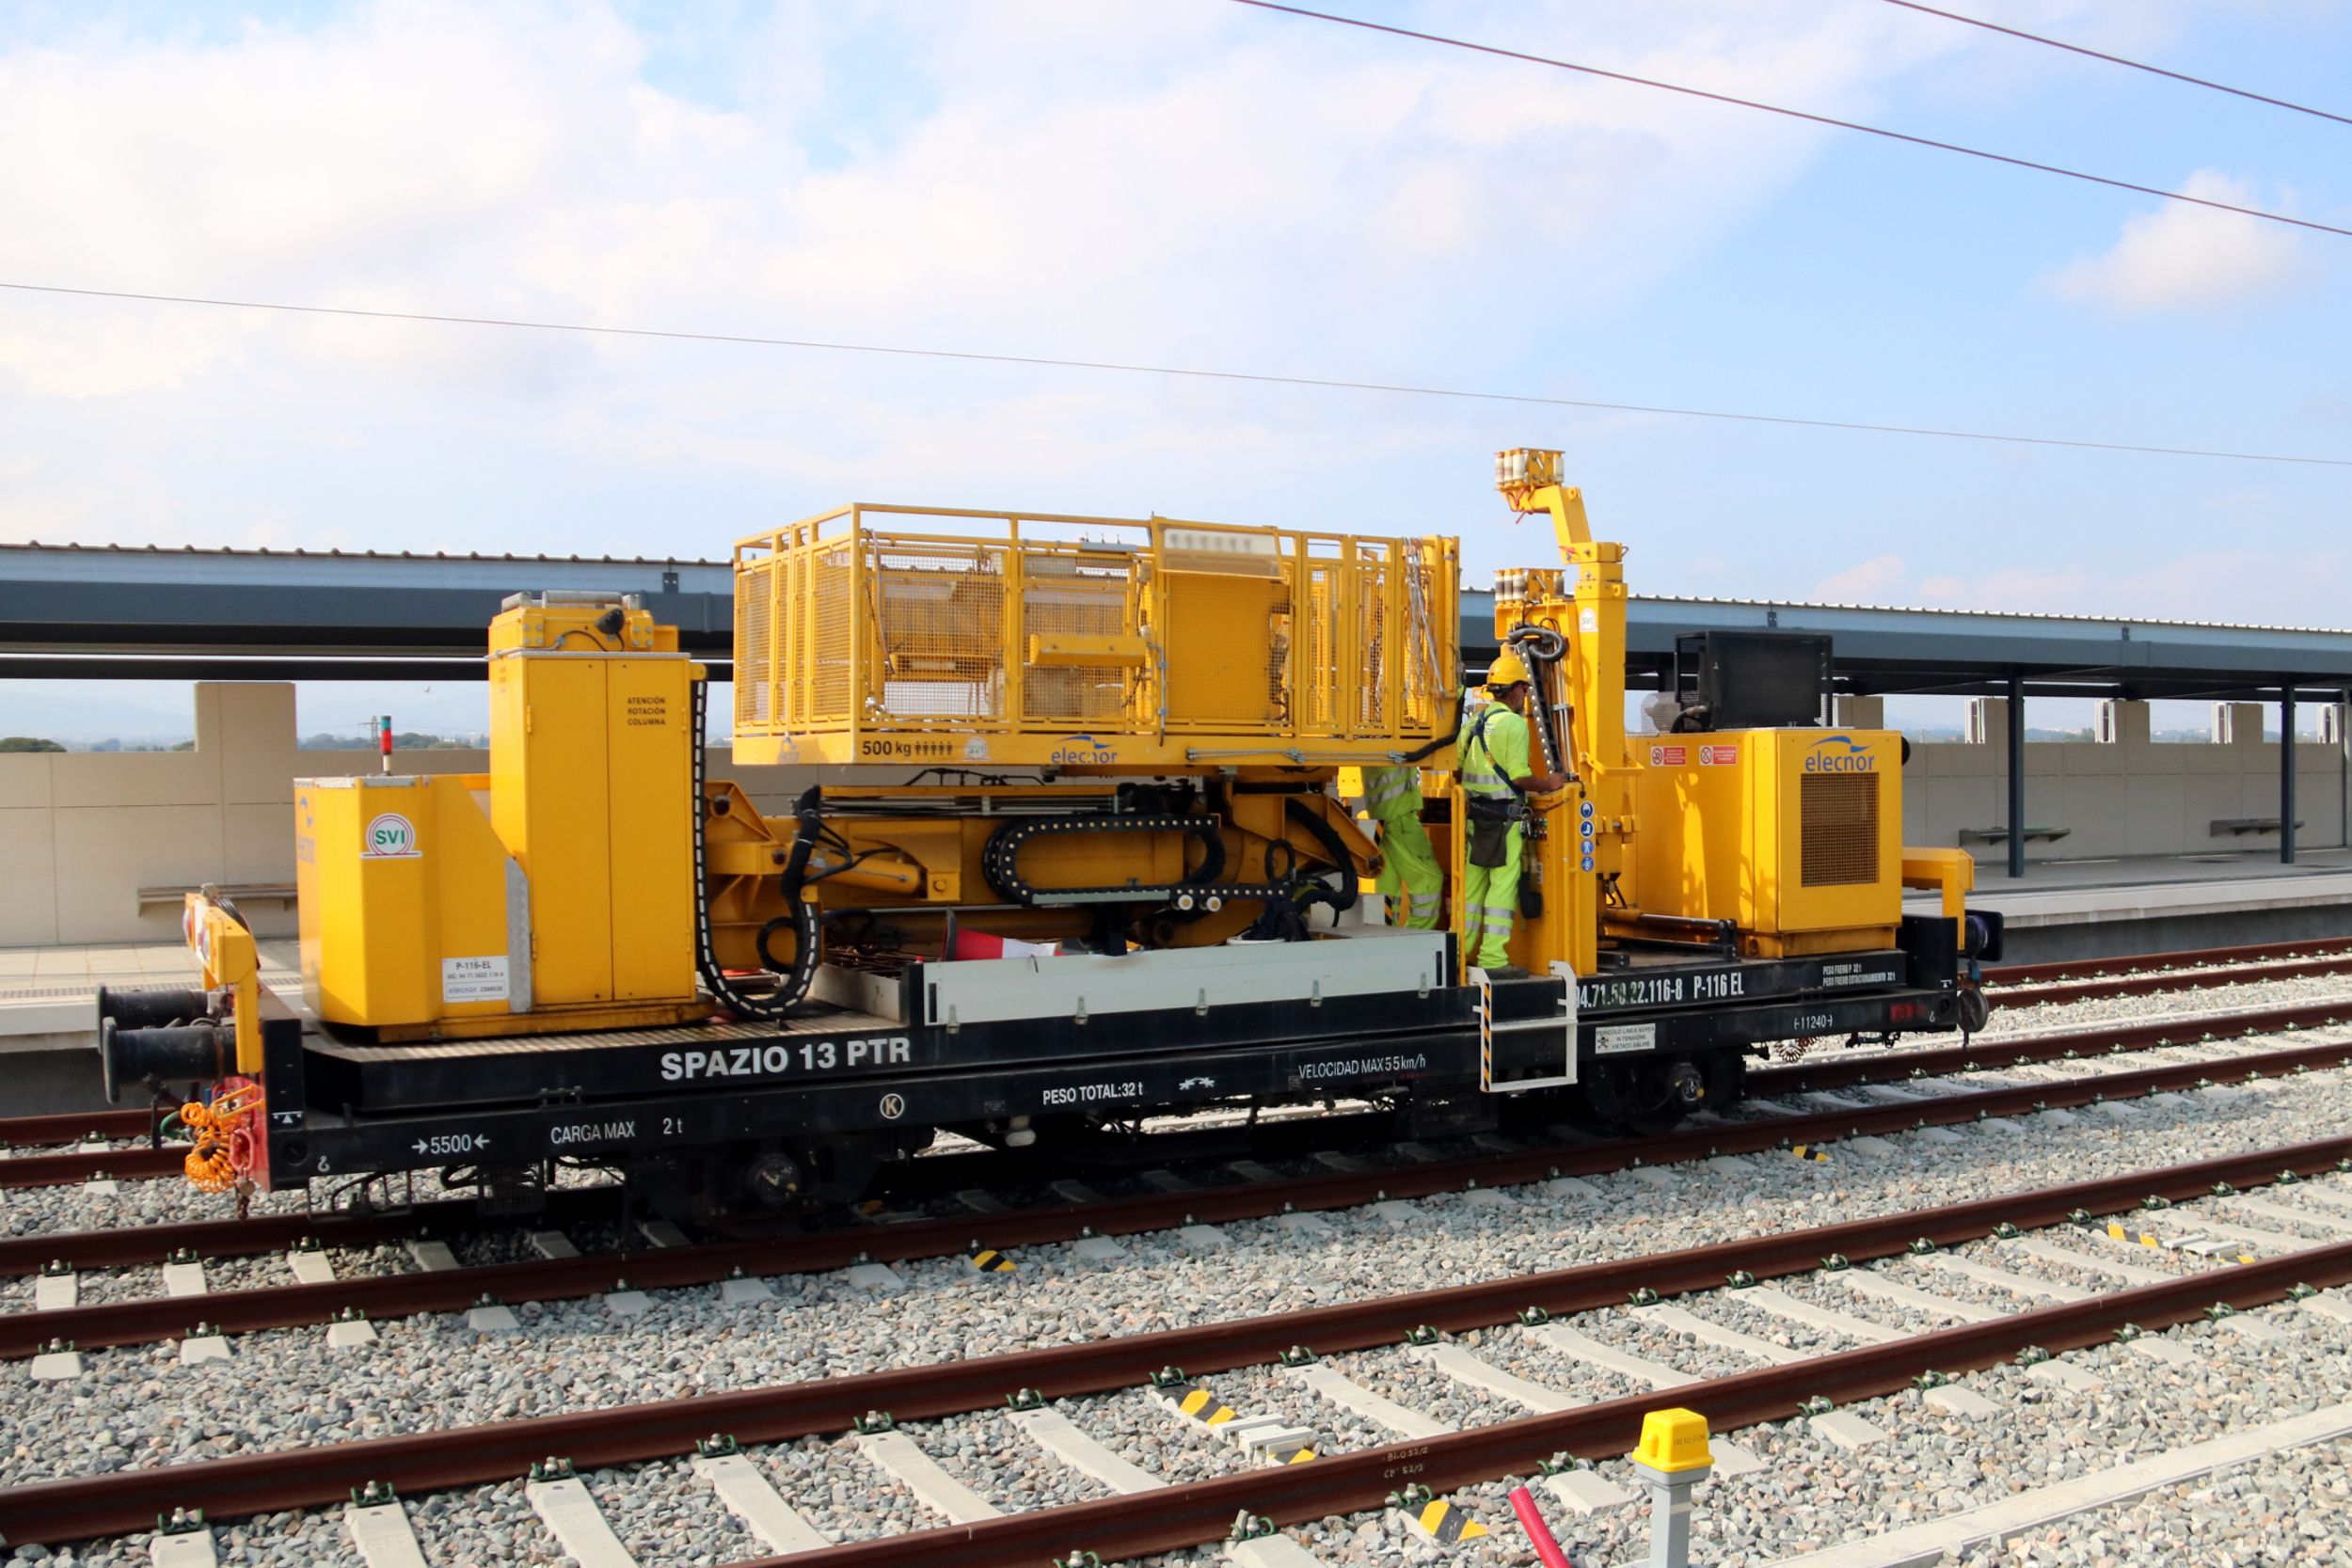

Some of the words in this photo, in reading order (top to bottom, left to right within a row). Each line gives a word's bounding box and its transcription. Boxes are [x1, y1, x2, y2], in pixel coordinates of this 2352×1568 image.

[862, 740, 892, 755] 500
[895, 741, 911, 756] kg
[1805, 750, 1875, 771] elecnor
[375, 830, 405, 845] SVI
[455, 961, 492, 970] P-116-EL
[449, 986, 478, 994] elecnor
[1694, 974, 1727, 999] P-116
[1730, 972, 1744, 995] EL
[660, 1046, 788, 1081] SPAZIO
[799, 1042, 836, 1070] 13
[847, 1037, 910, 1067] PTR
[1298, 1060, 1359, 1079] VELOCIDAD
[1043, 1087, 1076, 1105] PESO
[885, 1097, 898, 1116] K
[550, 1124, 601, 1145] CARGA
[604, 1121, 635, 1140] MAX
[662, 1118, 673, 1135] 2
[676, 1118, 682, 1133] t
[430, 1134, 471, 1154] 5500
